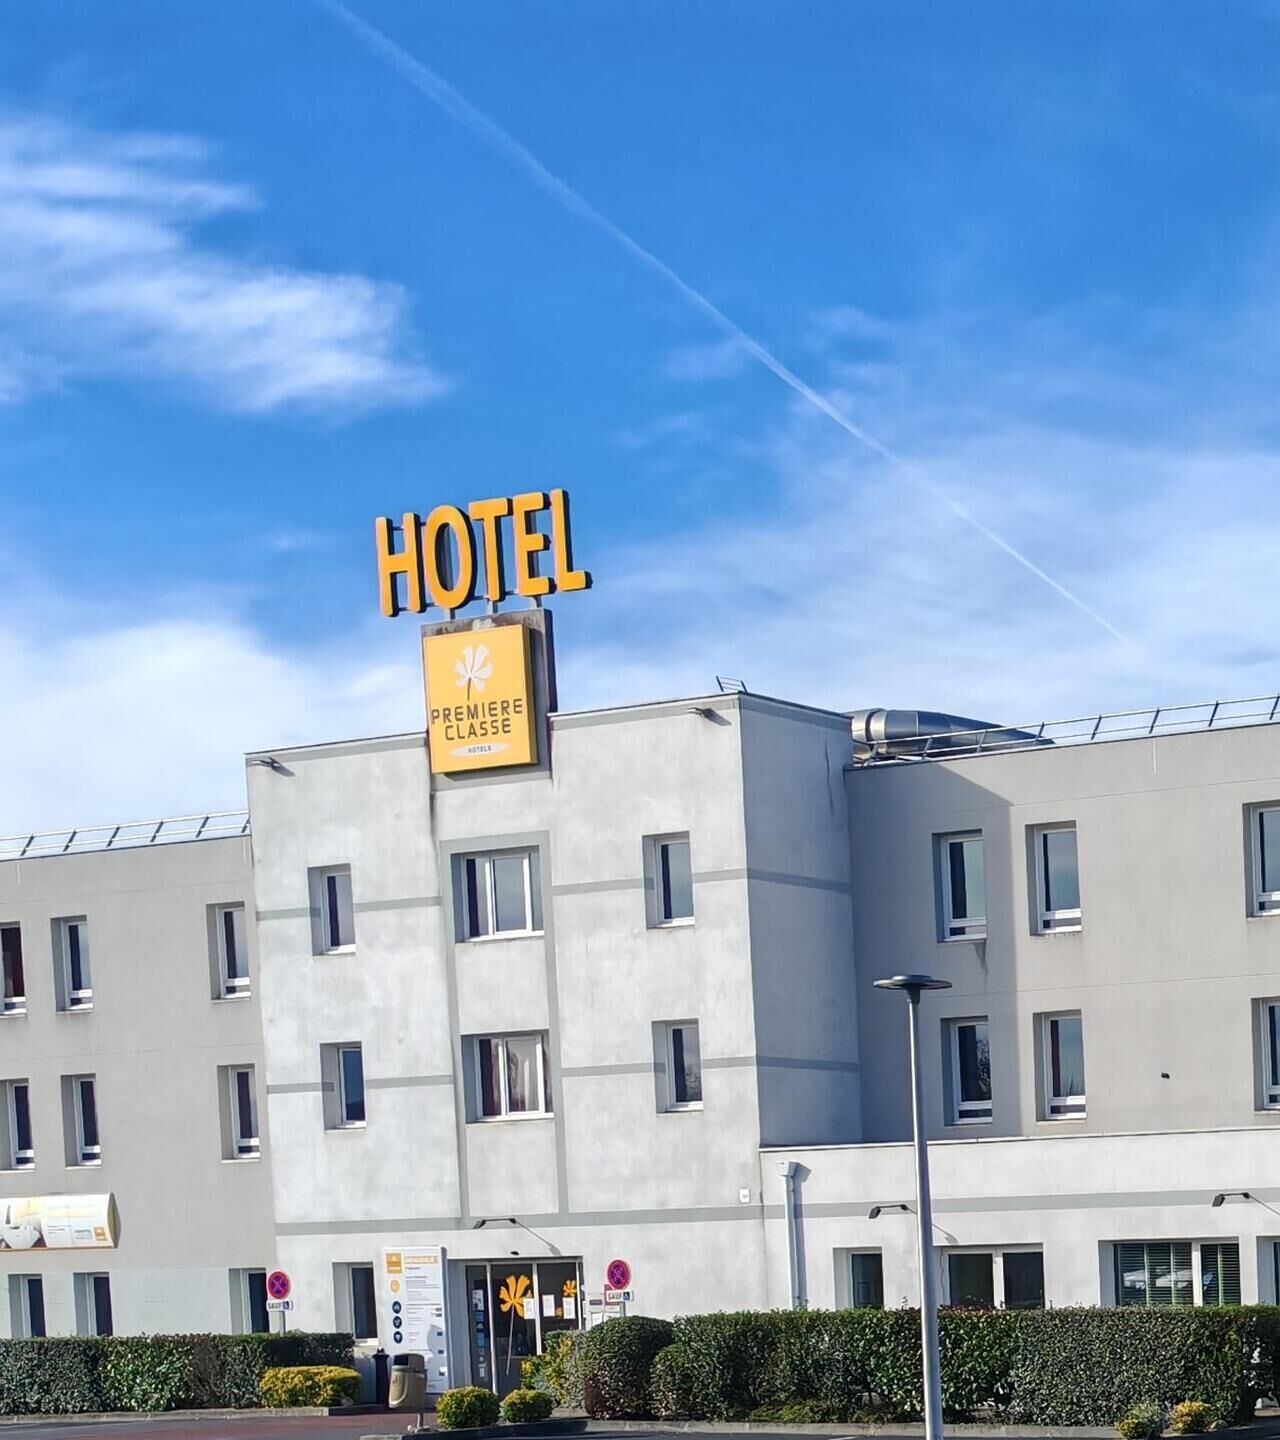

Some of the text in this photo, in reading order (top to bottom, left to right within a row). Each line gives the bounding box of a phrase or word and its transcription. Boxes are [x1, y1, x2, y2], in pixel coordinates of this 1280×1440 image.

[375, 488, 591, 617] HOTEL
[431, 698, 523, 725] PREMIERE
[445, 717, 511, 741] CLASSE
[468, 745, 492, 753] HOTELS
